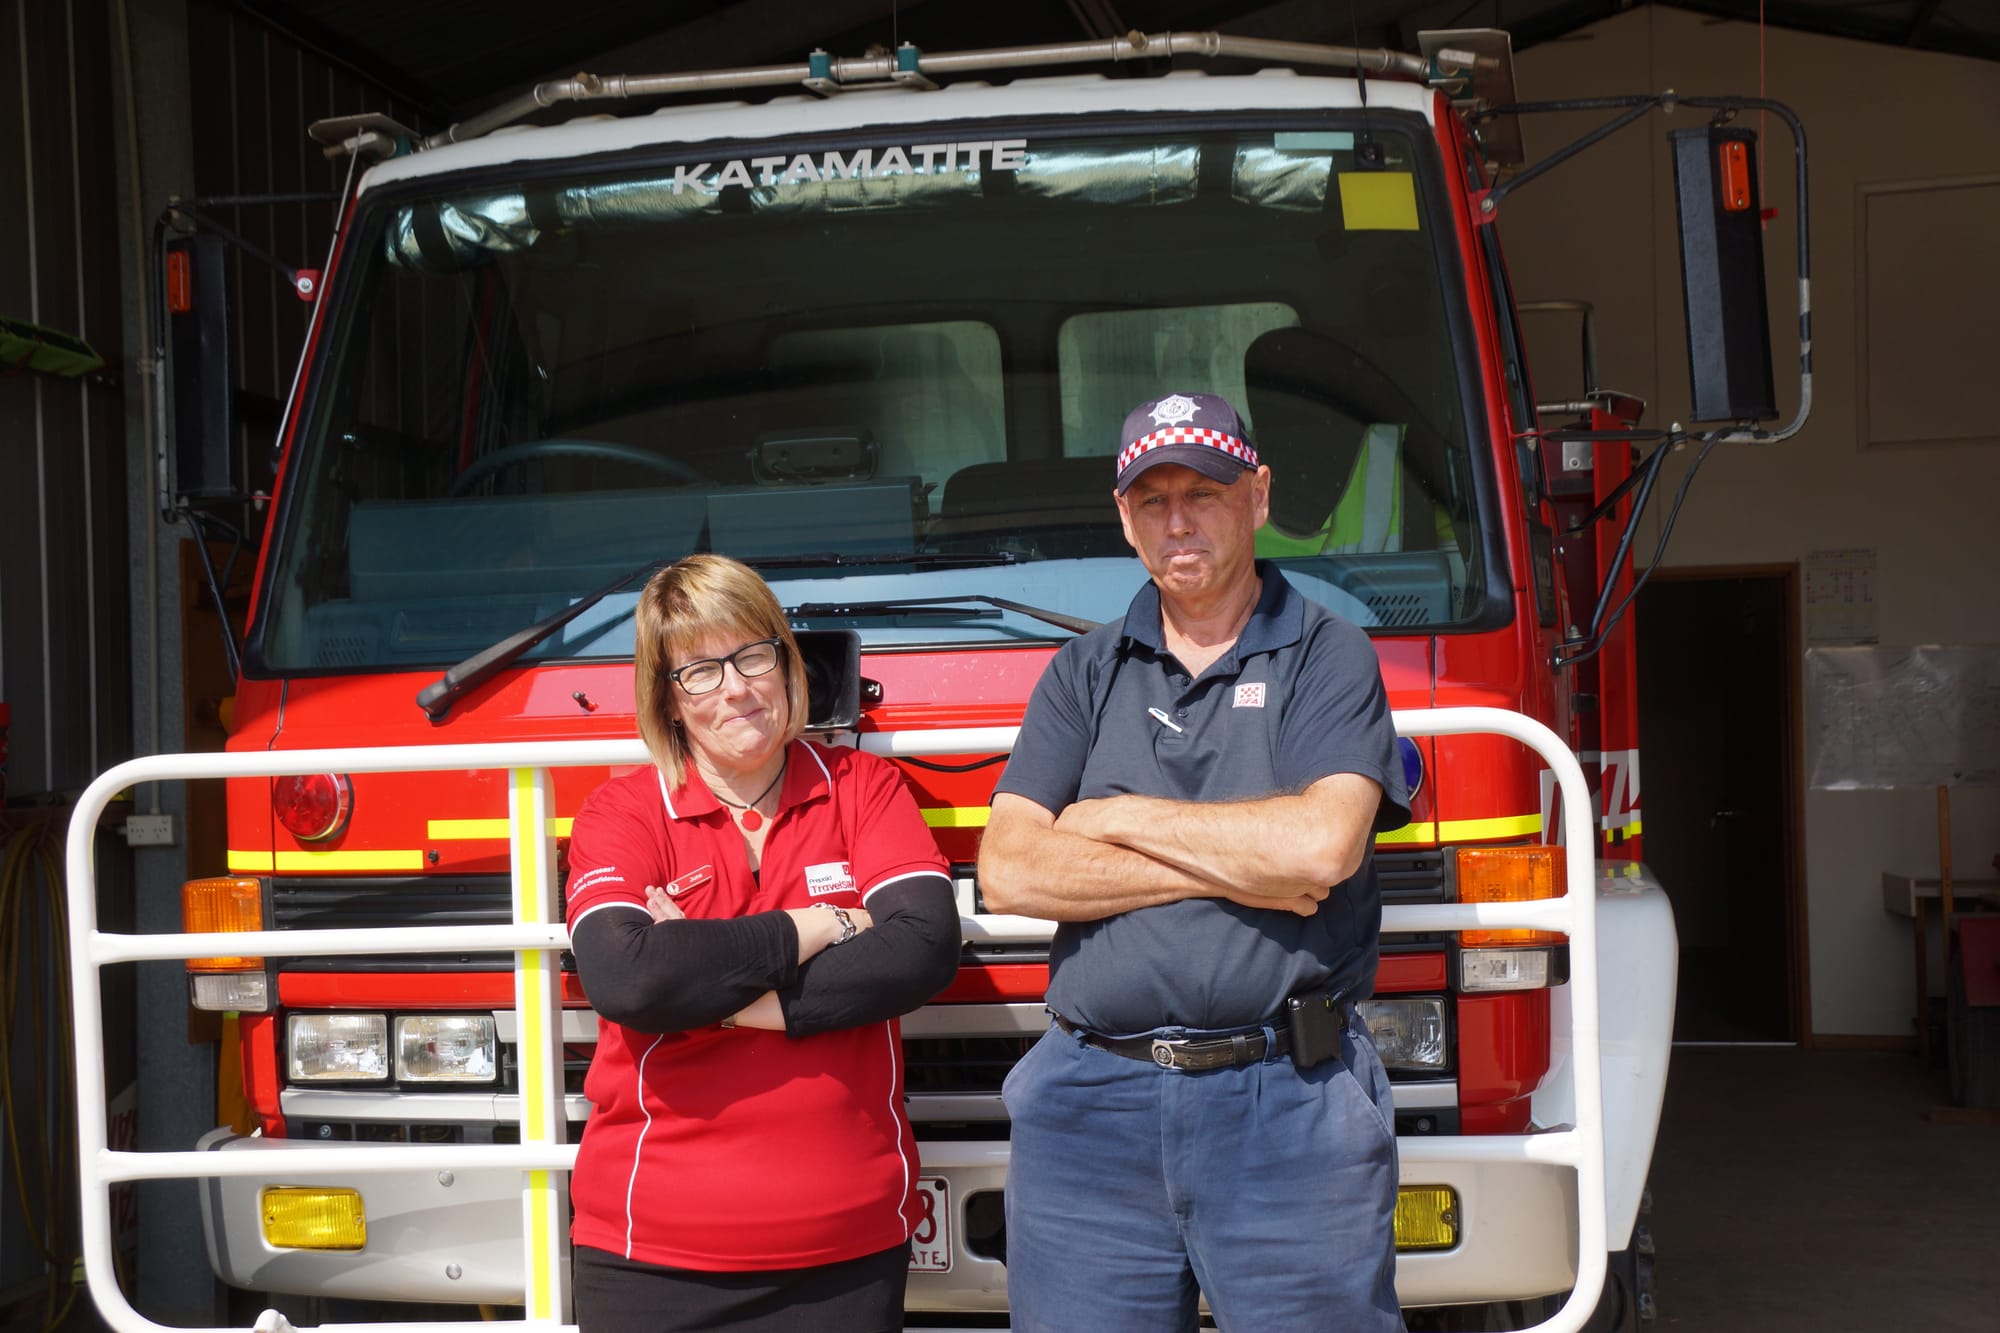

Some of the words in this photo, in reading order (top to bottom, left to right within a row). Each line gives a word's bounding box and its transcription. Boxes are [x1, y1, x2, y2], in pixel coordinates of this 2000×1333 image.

[672, 138, 1028, 196] KATAMATITE
[809, 875, 833, 885] Prepaid
[909, 1251, 941, 1266] ATE
